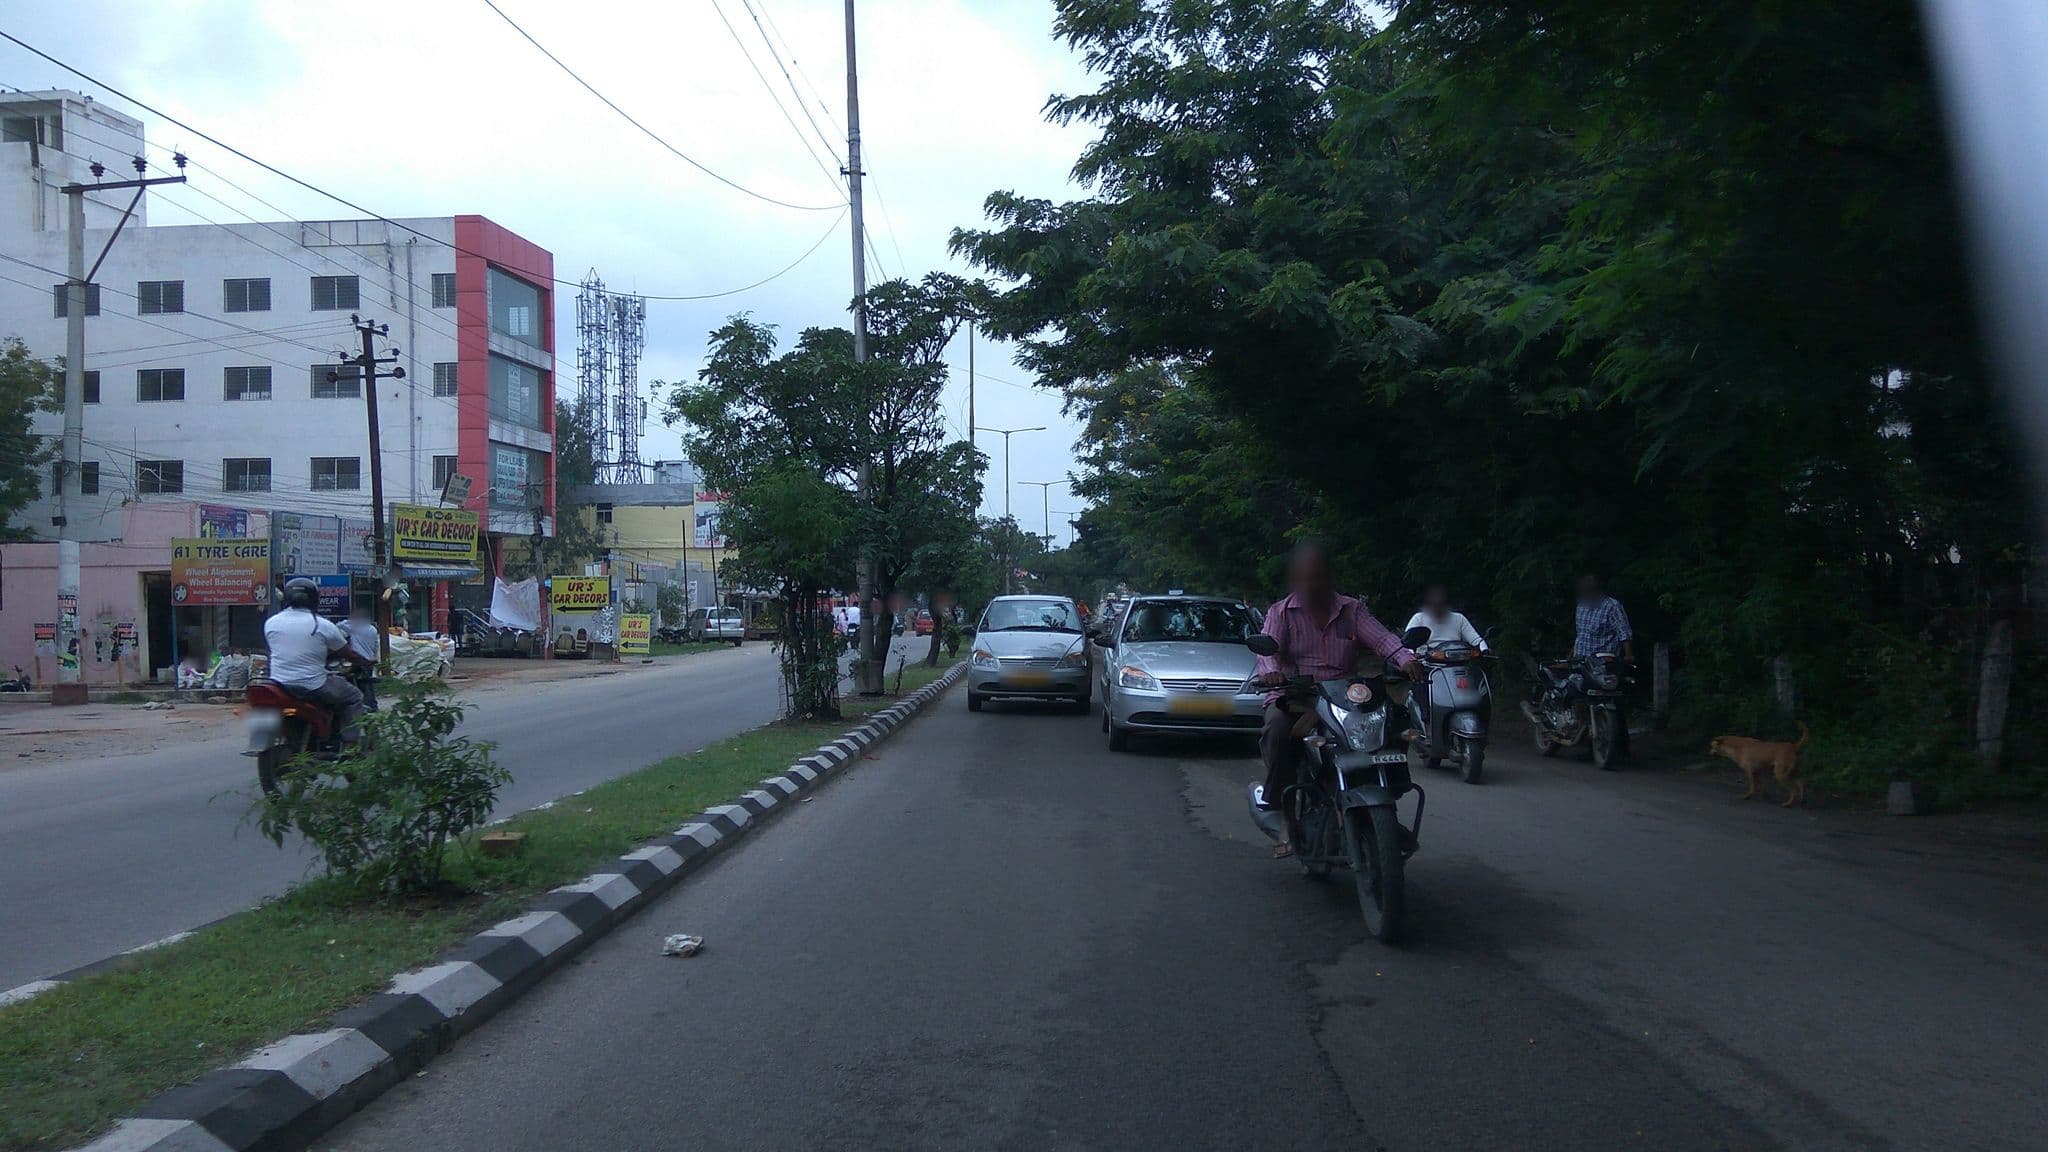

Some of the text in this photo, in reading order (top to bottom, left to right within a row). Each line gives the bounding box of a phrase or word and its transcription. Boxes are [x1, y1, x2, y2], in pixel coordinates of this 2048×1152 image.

[498, 453, 509, 465] FOR
[396, 517, 418, 536] UR'S
[420, 520, 439, 539] CAR
[441, 523, 477, 541] DECORS
[174, 545, 268, 559] A1 TYRE CARE
[185, 568, 209, 577] Wheel
[189, 578, 252, 588] Wheel Balancing
[567, 581, 595, 592] UR'S
[553, 593, 608, 605] CAR DECORS
[628, 620, 643, 629] UR'S
[621, 630, 649, 640] CAR DECORS
